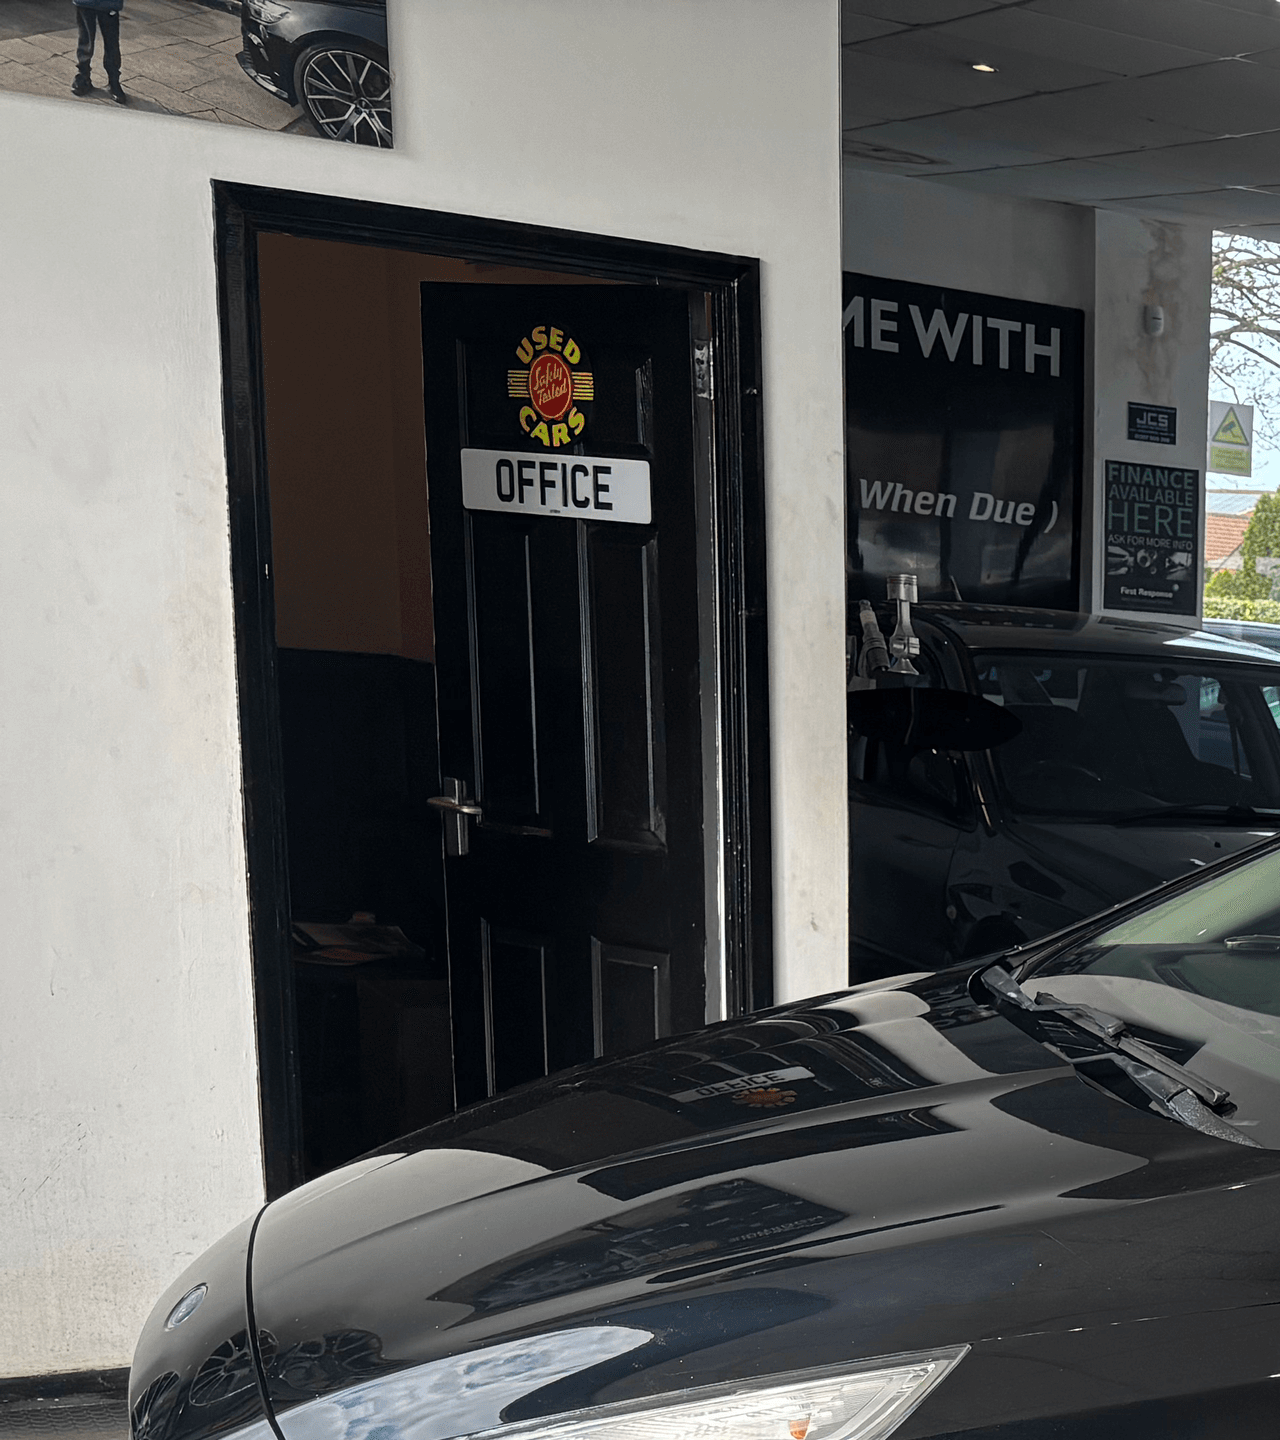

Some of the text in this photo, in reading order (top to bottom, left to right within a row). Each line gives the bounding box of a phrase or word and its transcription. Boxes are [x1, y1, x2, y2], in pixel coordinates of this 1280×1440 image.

[516, 326, 581, 364] USED
[907, 304, 1061, 377] WITH
[537, 378, 568, 405] Tested
[519, 405, 585, 447] CARS
[1136, 411, 1169, 428] JCS
[495, 458, 613, 511] OFFICE
[1108, 463, 1194, 490] FINANCE
[859, 478, 957, 518] When
[969, 491, 1036, 526] Due
[1109, 484, 1194, 507] AVAILABLE
[1108, 499, 1193, 538] HERE
[1108, 534, 1193, 551] ASK FOR MORE INFO
[1120, 586, 1174, 599] First Response
